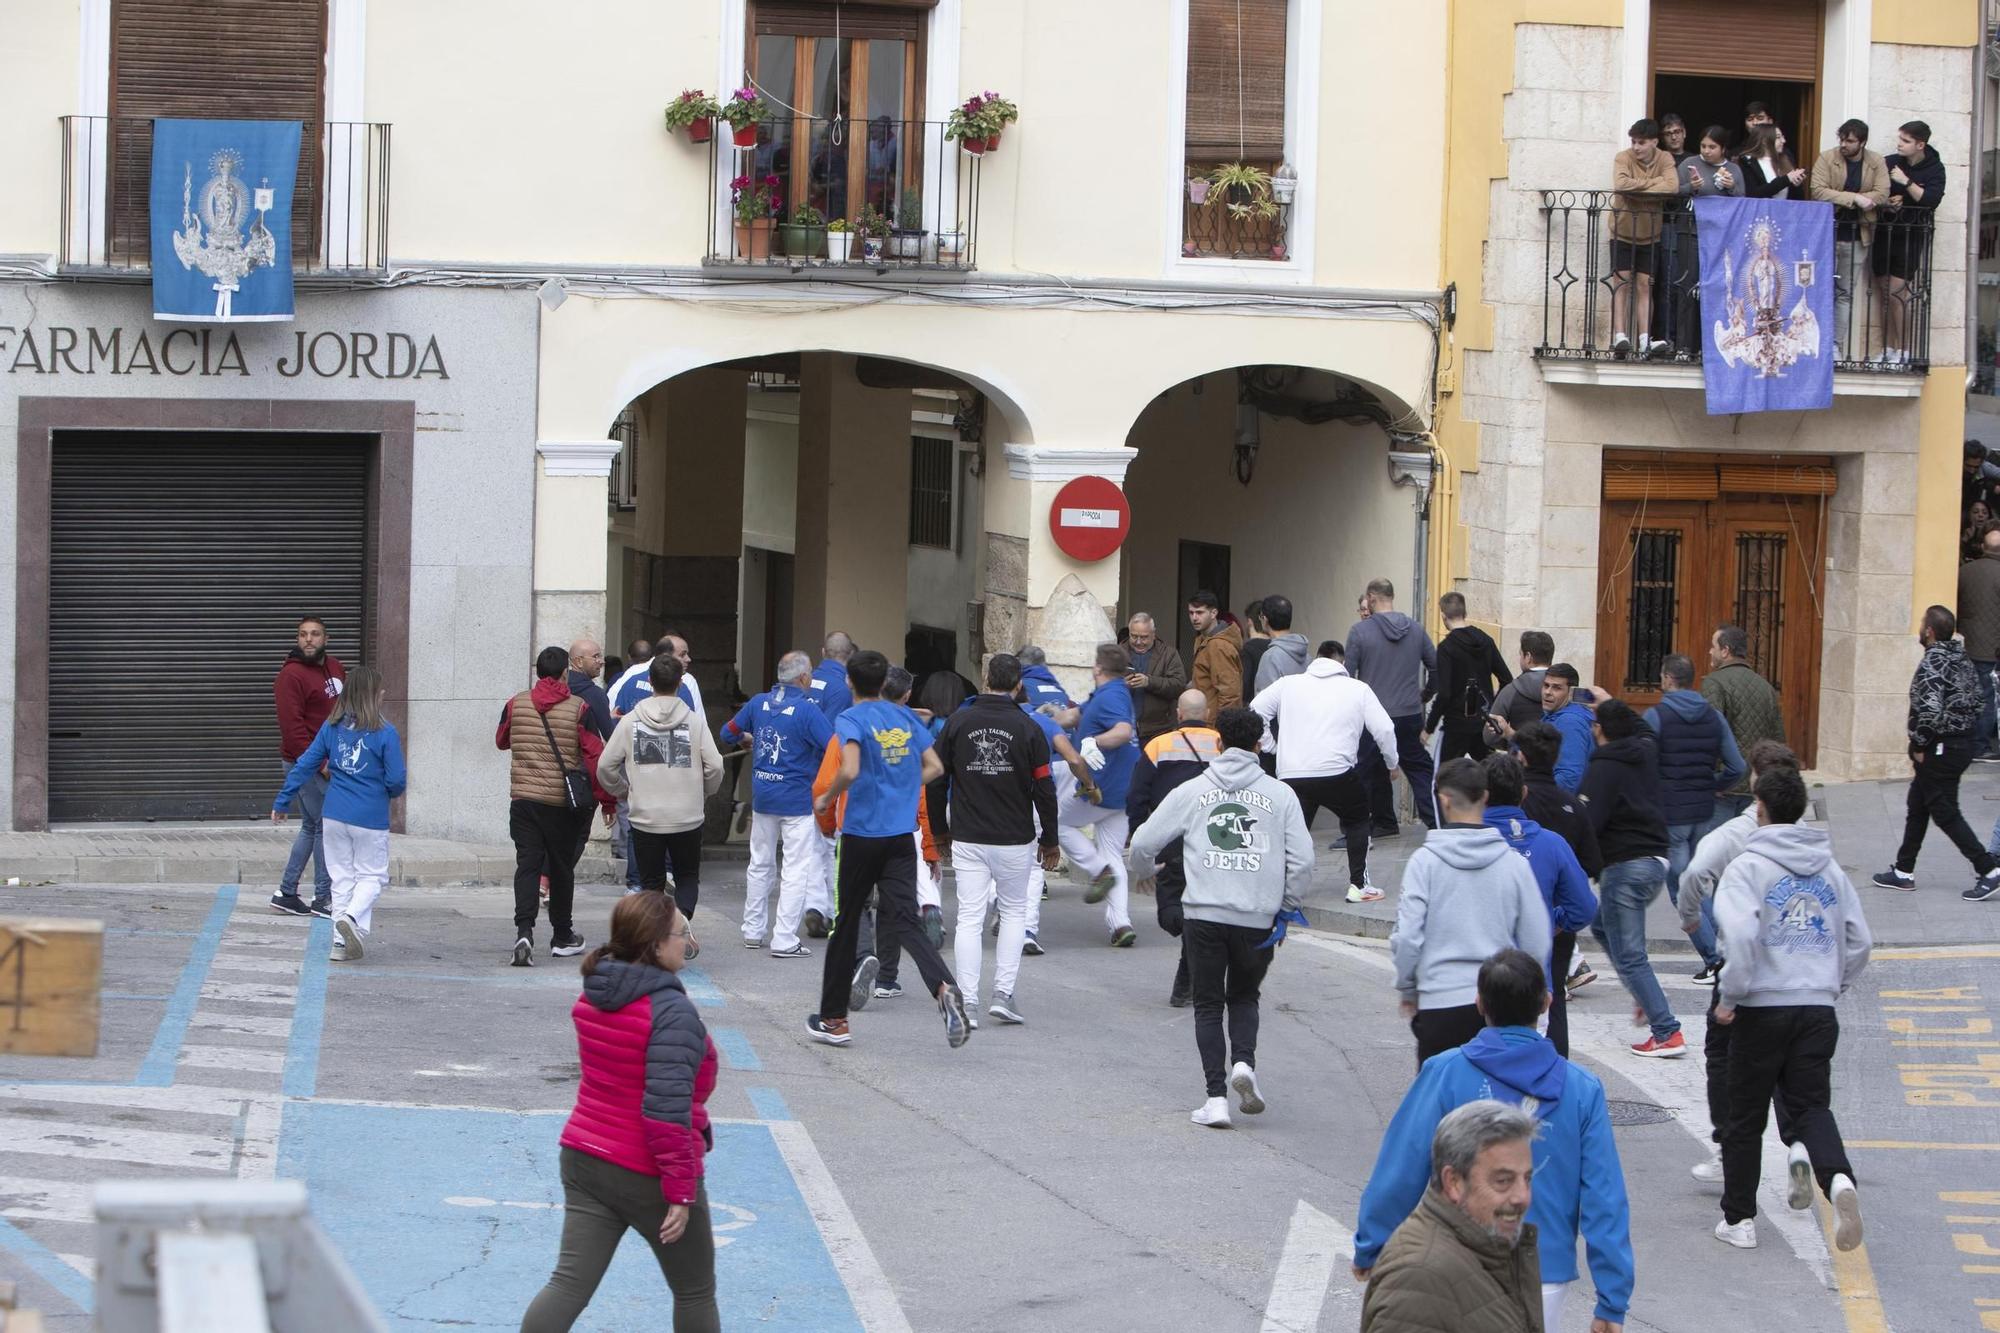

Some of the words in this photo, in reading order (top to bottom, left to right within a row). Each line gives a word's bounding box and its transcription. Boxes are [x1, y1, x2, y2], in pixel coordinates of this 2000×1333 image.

[276, 331, 450, 380] JORDA
[1198, 788, 1230, 810] NEW
[1234, 788, 1274, 814] YORK
[1203, 850, 1261, 872] JETS
[1784, 897, 1809, 931] 4
